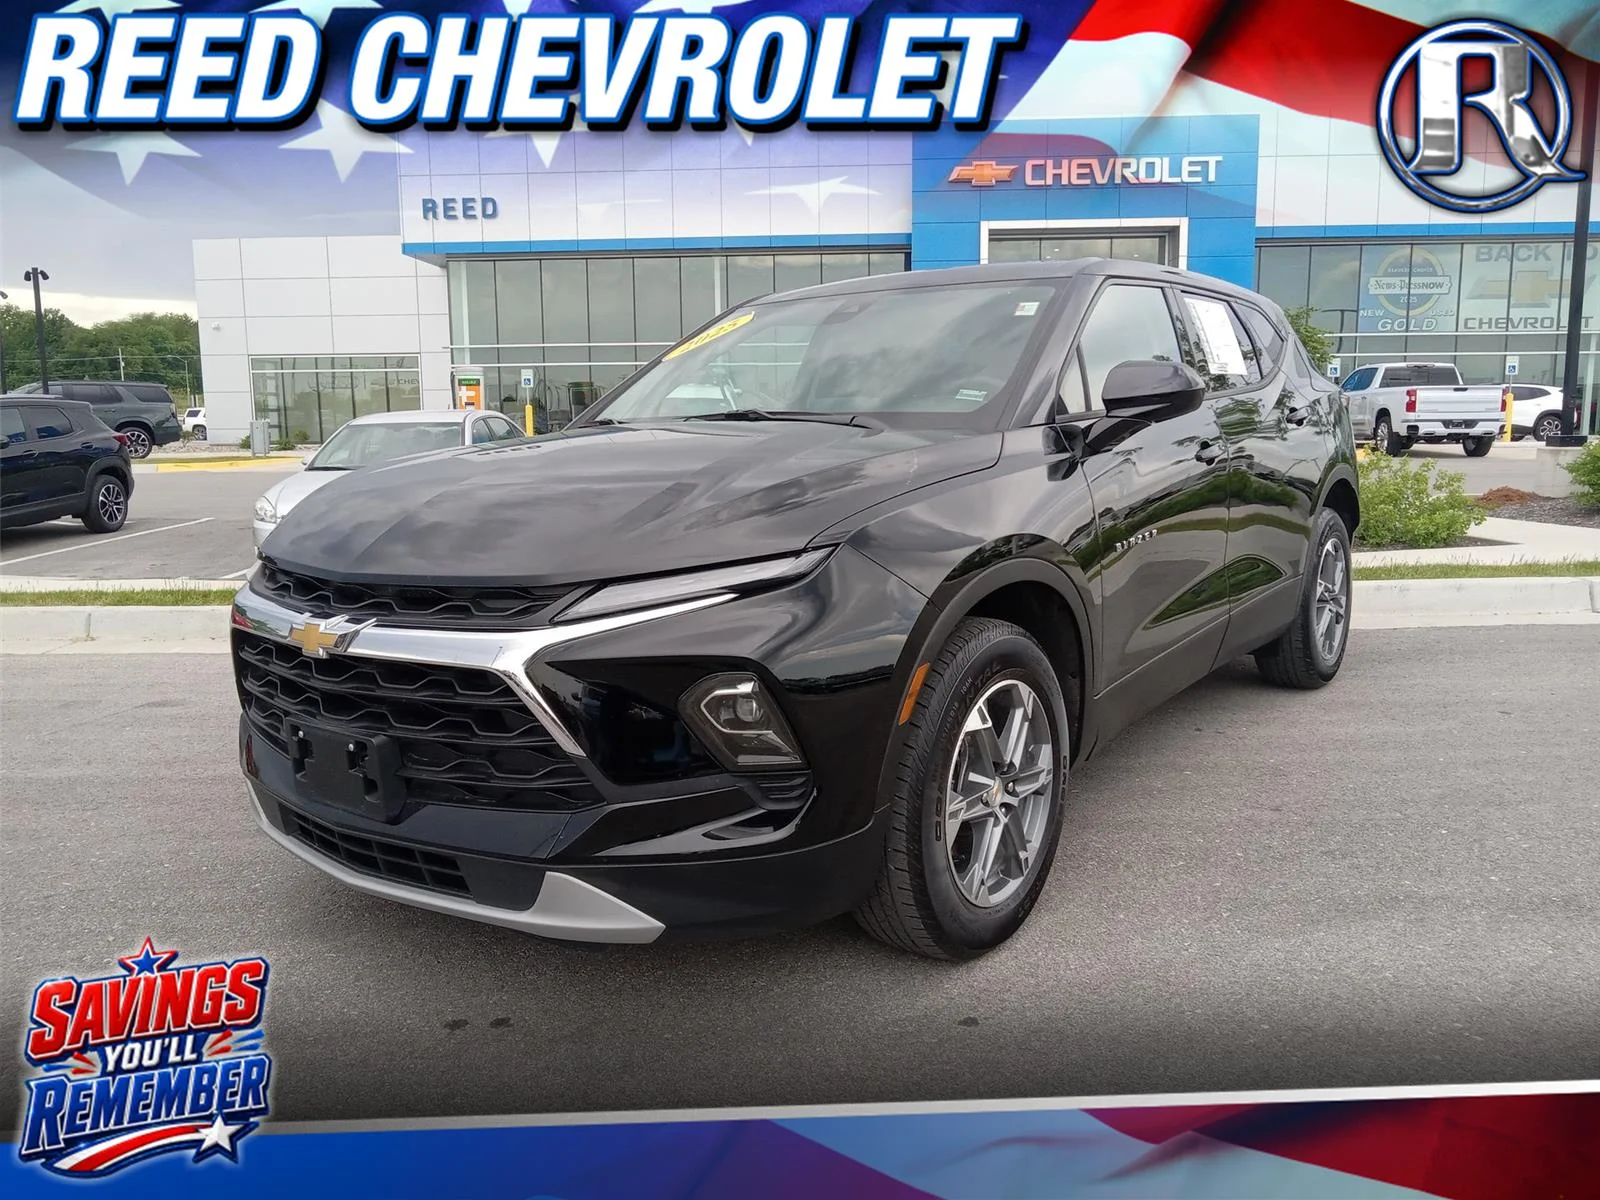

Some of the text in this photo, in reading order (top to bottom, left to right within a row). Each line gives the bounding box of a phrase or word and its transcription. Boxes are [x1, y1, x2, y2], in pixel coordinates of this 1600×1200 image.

[1025, 155, 1223, 186] CHEVROLET
[421, 196, 498, 221] REED
[1475, 244, 1554, 262] BACK
[1360, 309, 1384, 317] NEW
[1377, 318, 1437, 332] GOLD
[1463, 315, 1594, 330] CHEVROT
